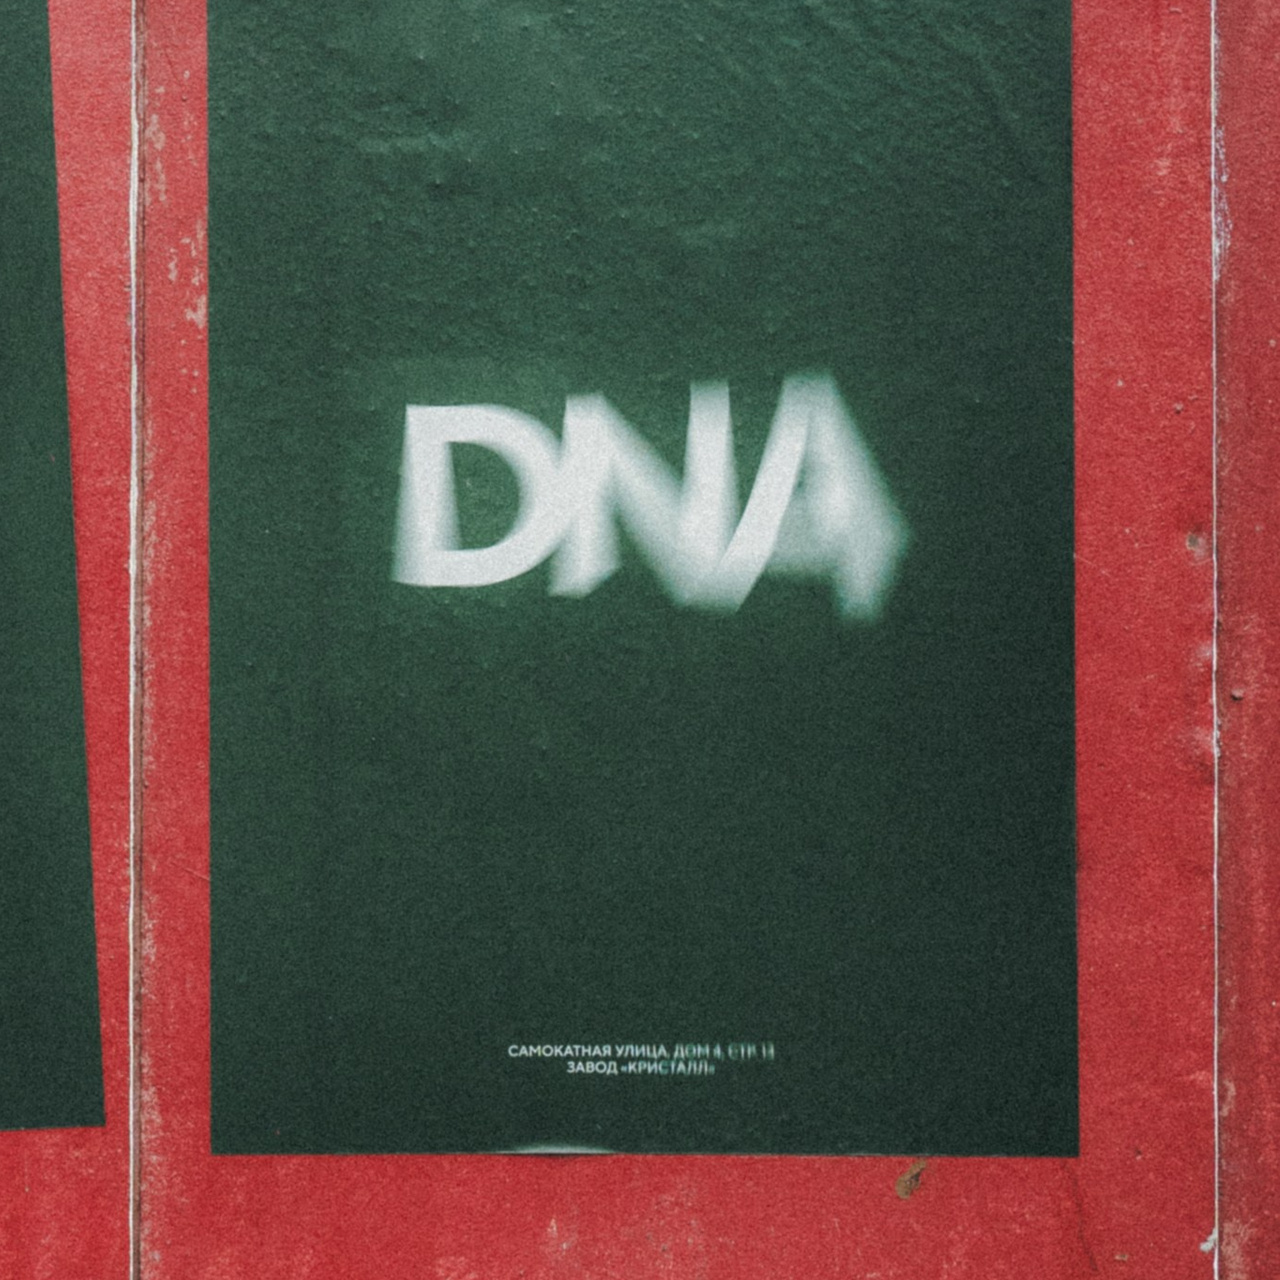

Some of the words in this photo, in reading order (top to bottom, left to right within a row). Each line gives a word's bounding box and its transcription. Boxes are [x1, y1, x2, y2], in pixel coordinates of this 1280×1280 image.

[392, 368, 912, 622] DNA
[508, 1044, 612, 1058] САМОКАТНАЯ
[673, 1043, 710, 1060] ДОМ
[567, 1061, 618, 1075] ЗАВОД
